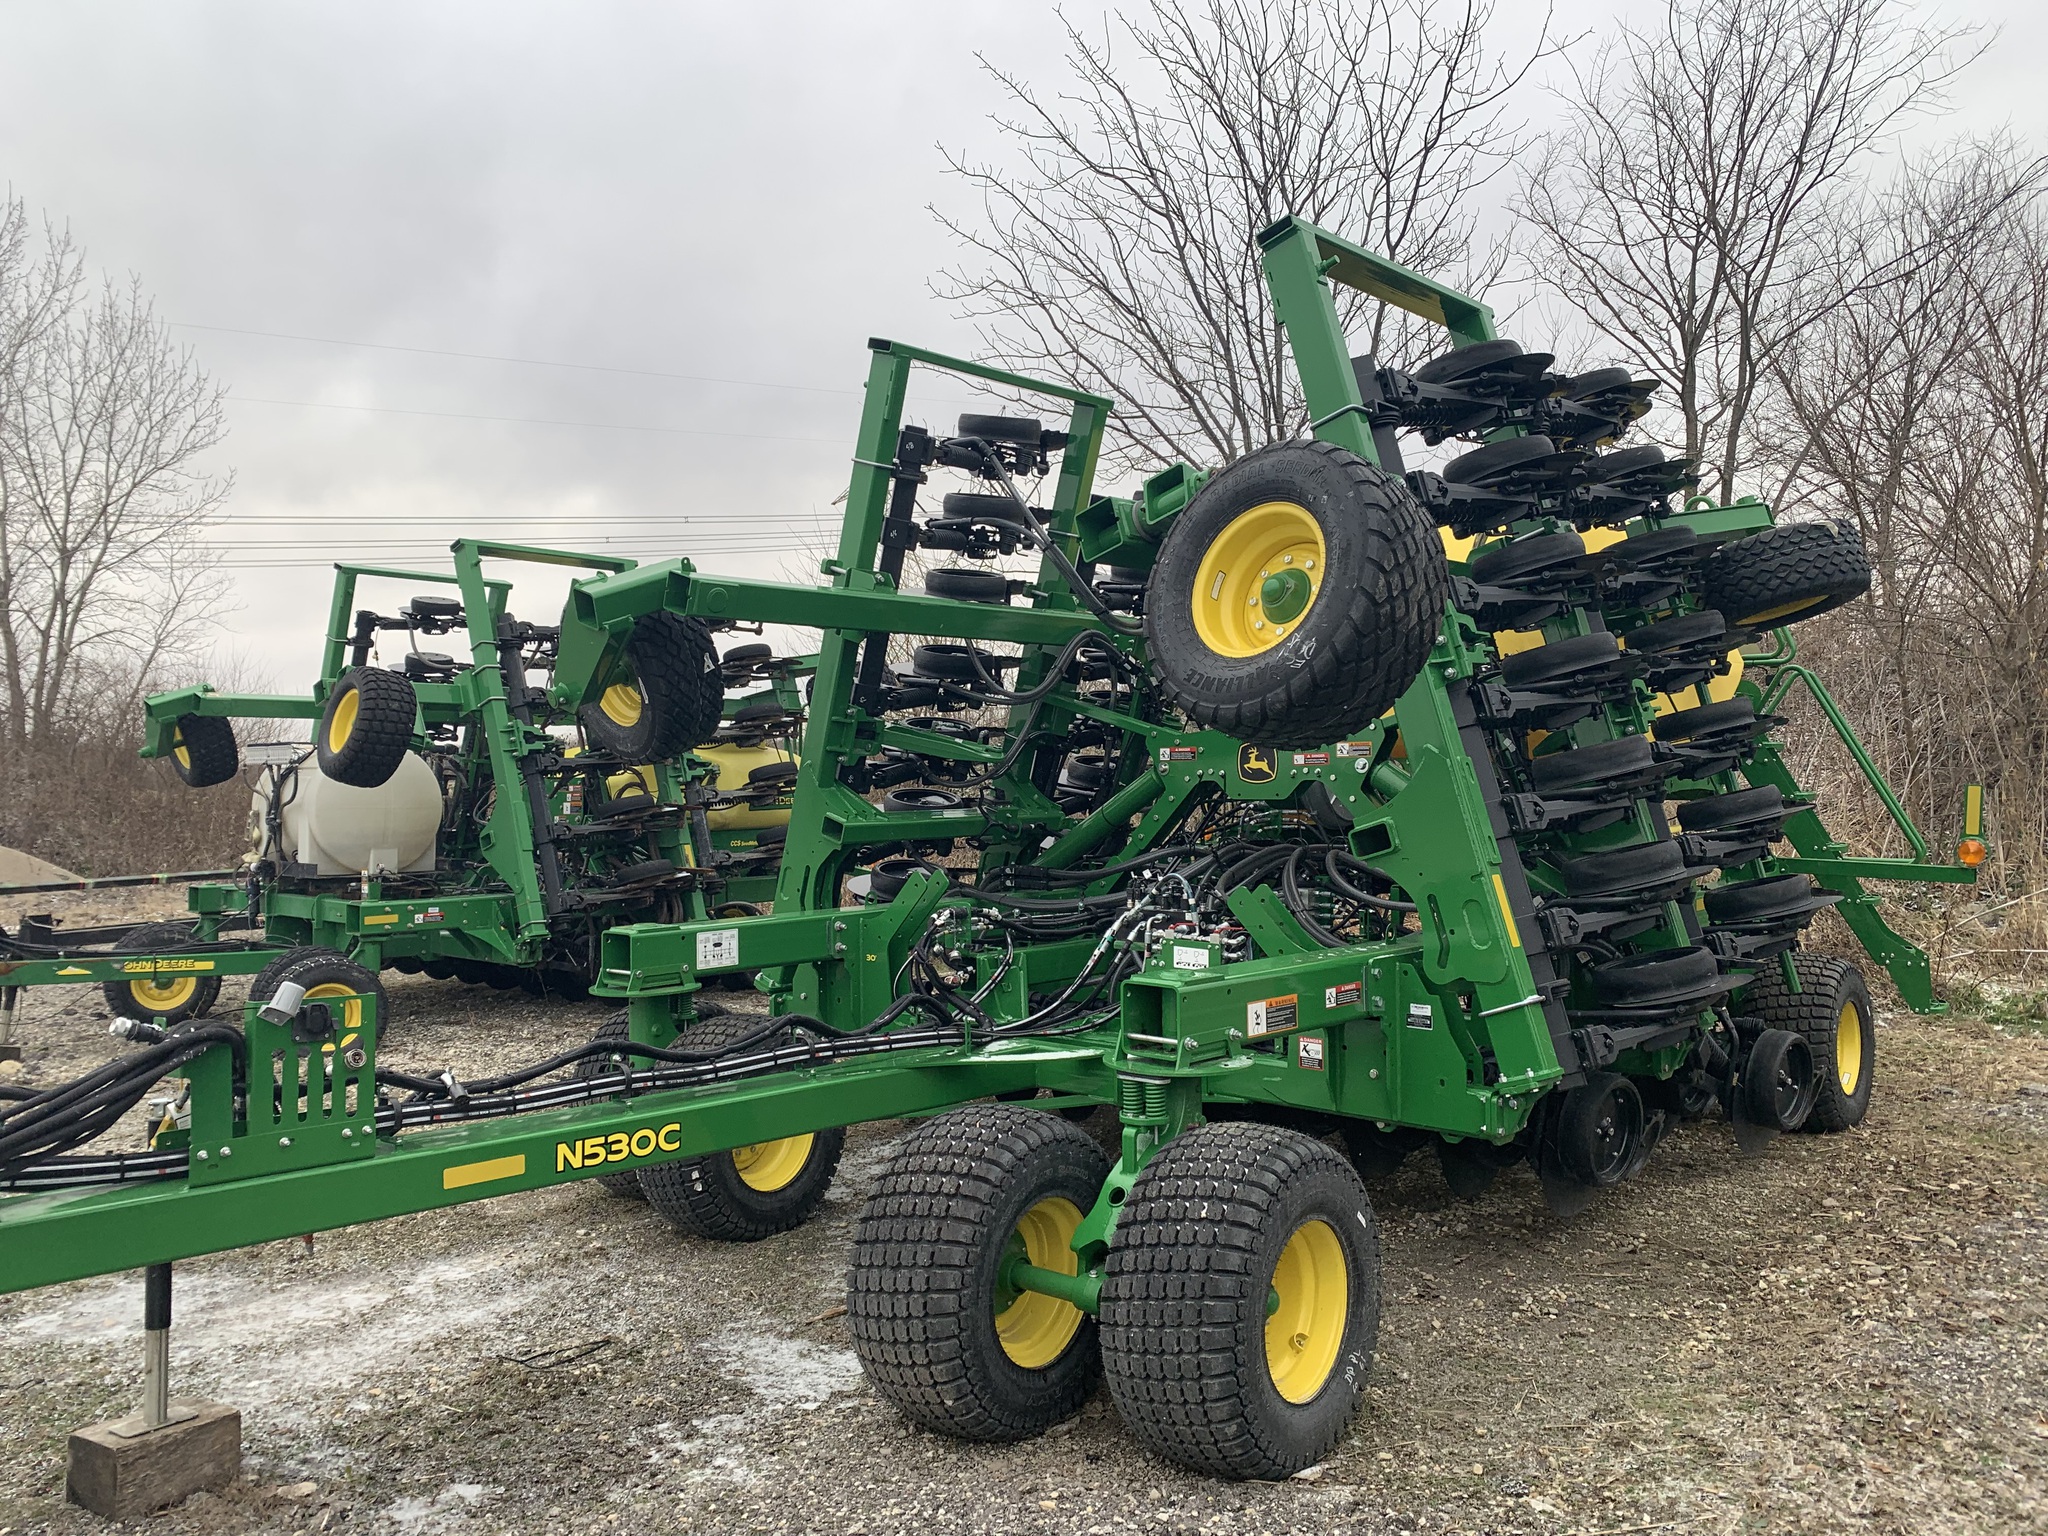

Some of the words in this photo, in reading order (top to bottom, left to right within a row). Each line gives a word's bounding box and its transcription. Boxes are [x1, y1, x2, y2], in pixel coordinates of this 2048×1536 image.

[1209, 462, 1266, 499] RADIAL
[1183, 662, 1270, 693] ALLIANCE
[124, 961, 151, 970] OHN
[155, 959, 195, 969] DEERE
[1274, 997, 1296, 1006] WARNING
[556, 1122, 681, 1173] N530C
